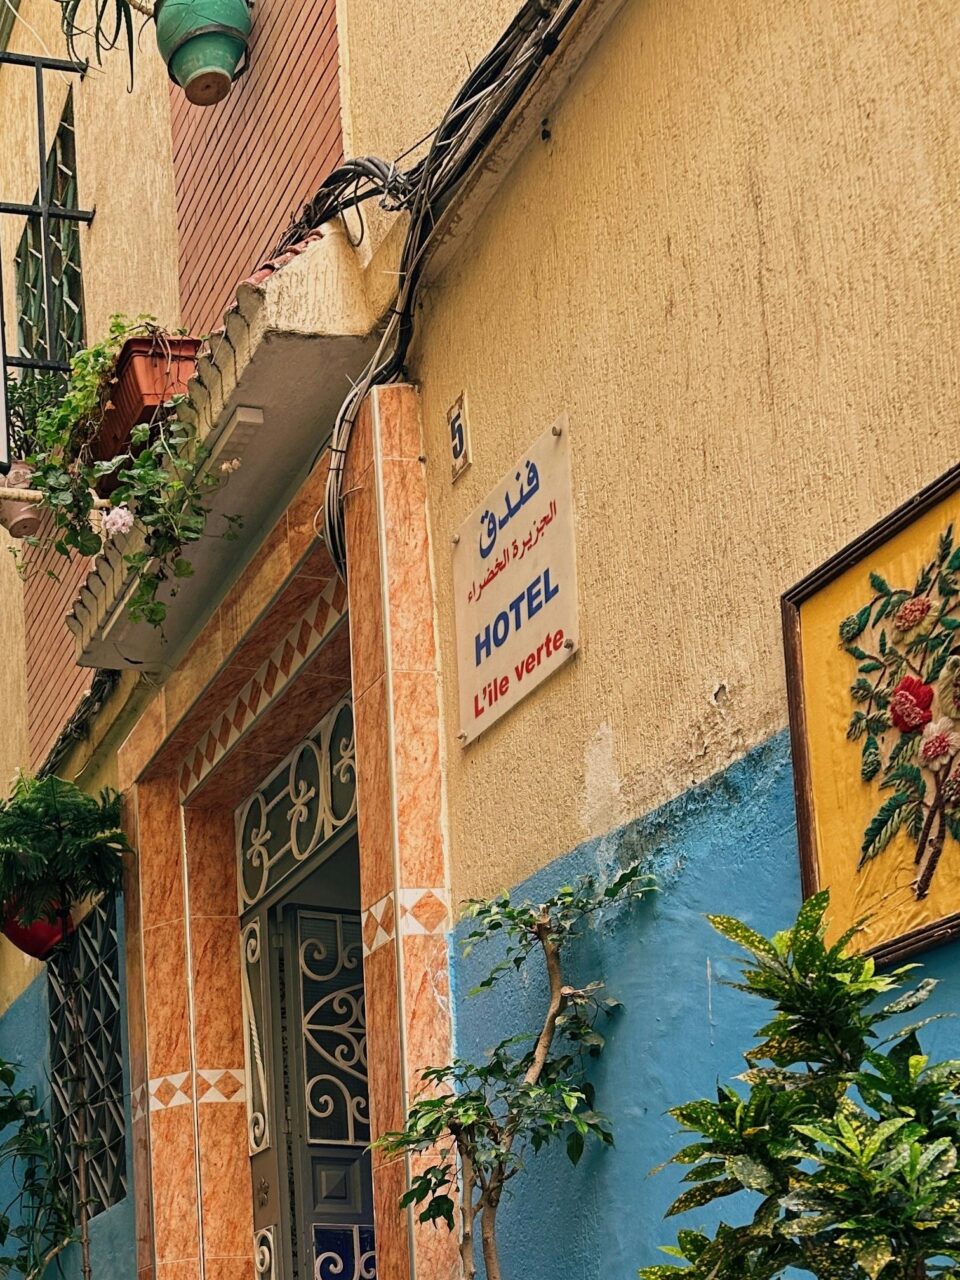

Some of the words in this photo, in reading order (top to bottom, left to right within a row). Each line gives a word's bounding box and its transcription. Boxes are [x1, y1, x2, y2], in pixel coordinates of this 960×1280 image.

[451, 412, 464, 459] 5
[479, 459, 540, 559] فندق
[512, 499, 557, 559] الجزيرة
[467, 547, 510, 604] الخضراء
[474, 567, 560, 668] HOTEL
[473, 674, 510, 719] L'ile
[514, 628, 565, 682] verte
